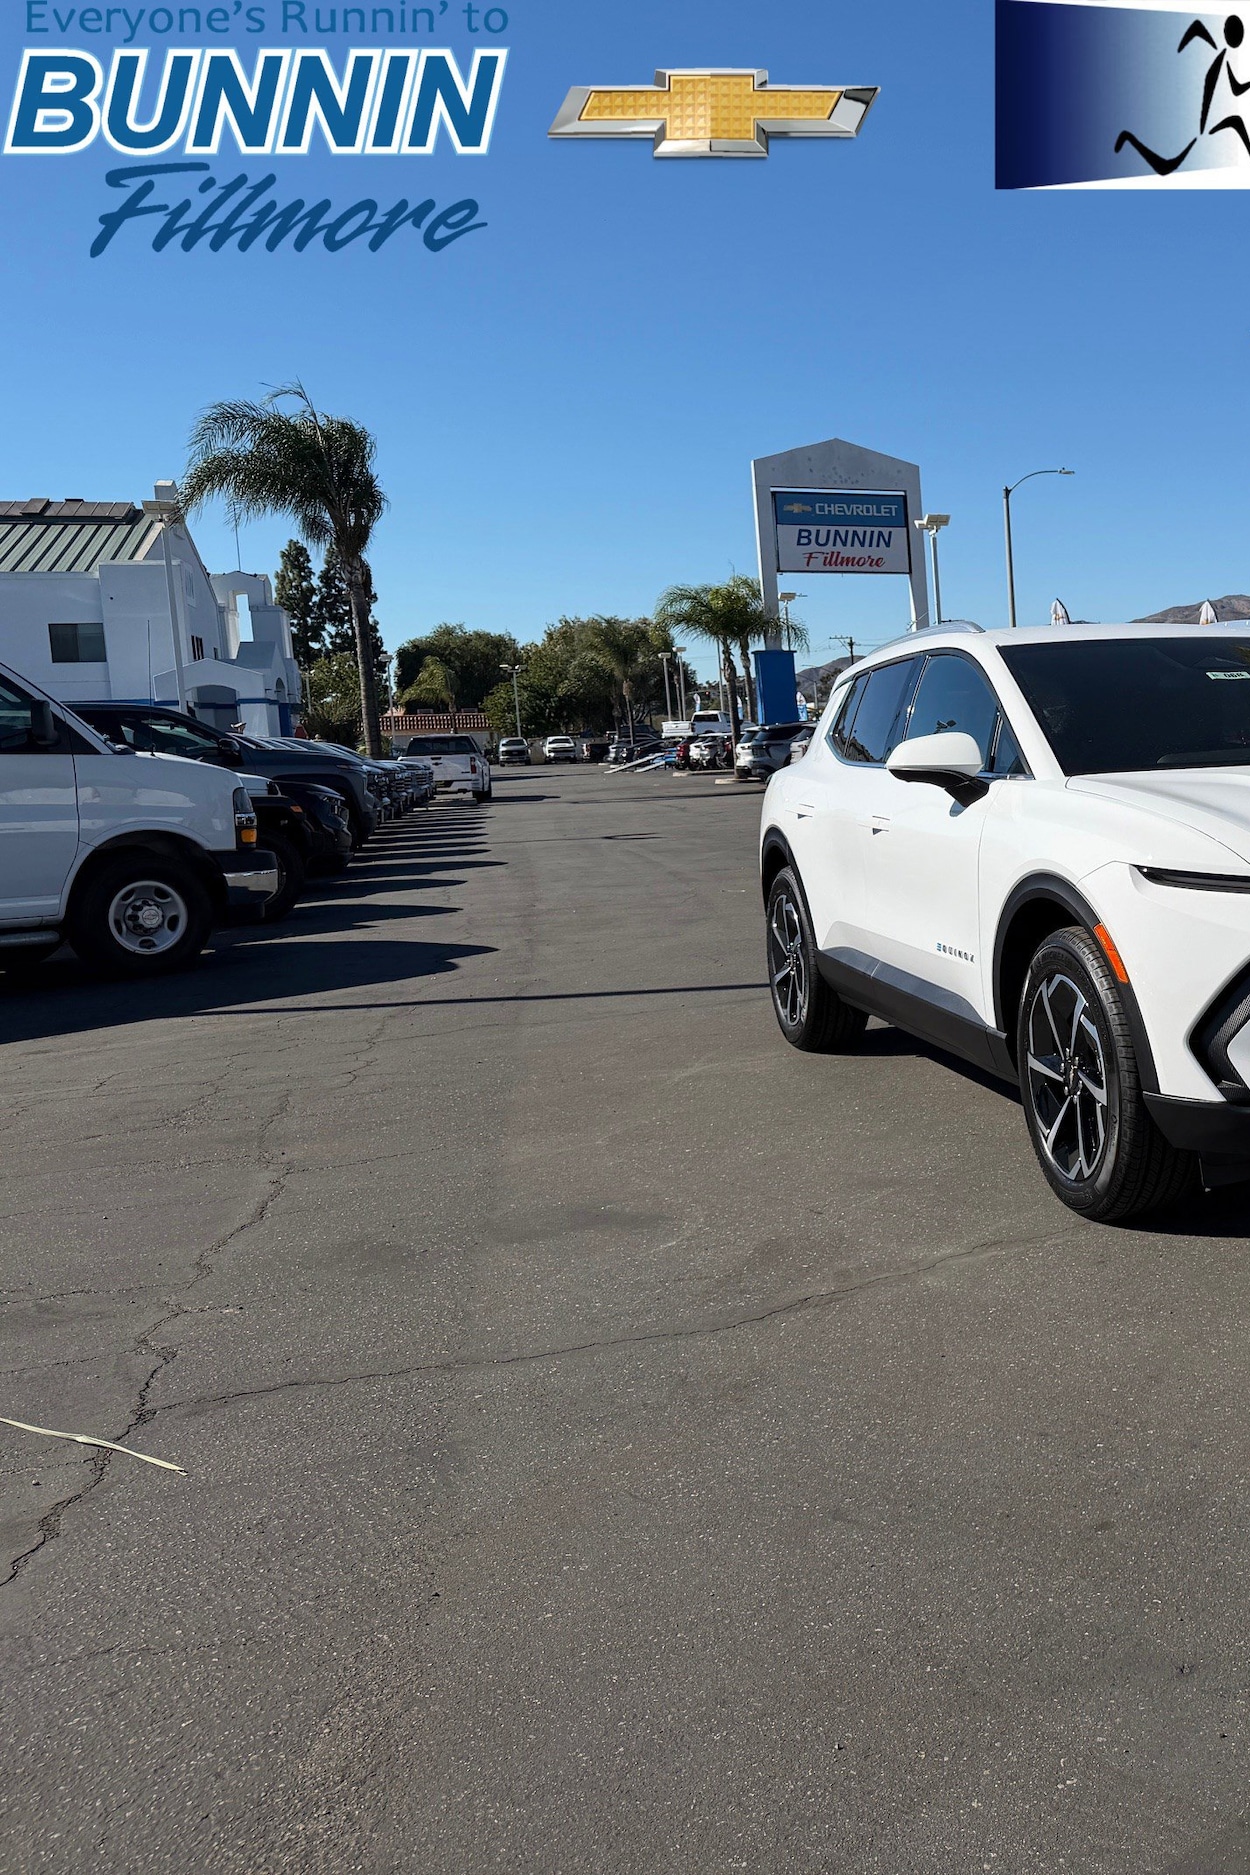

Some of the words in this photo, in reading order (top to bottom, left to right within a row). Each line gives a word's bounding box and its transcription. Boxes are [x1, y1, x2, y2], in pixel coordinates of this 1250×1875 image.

[815, 503, 898, 517] CHEVROLET
[797, 528, 892, 548] BUNNIN
[802, 551, 885, 568] Fillmore
